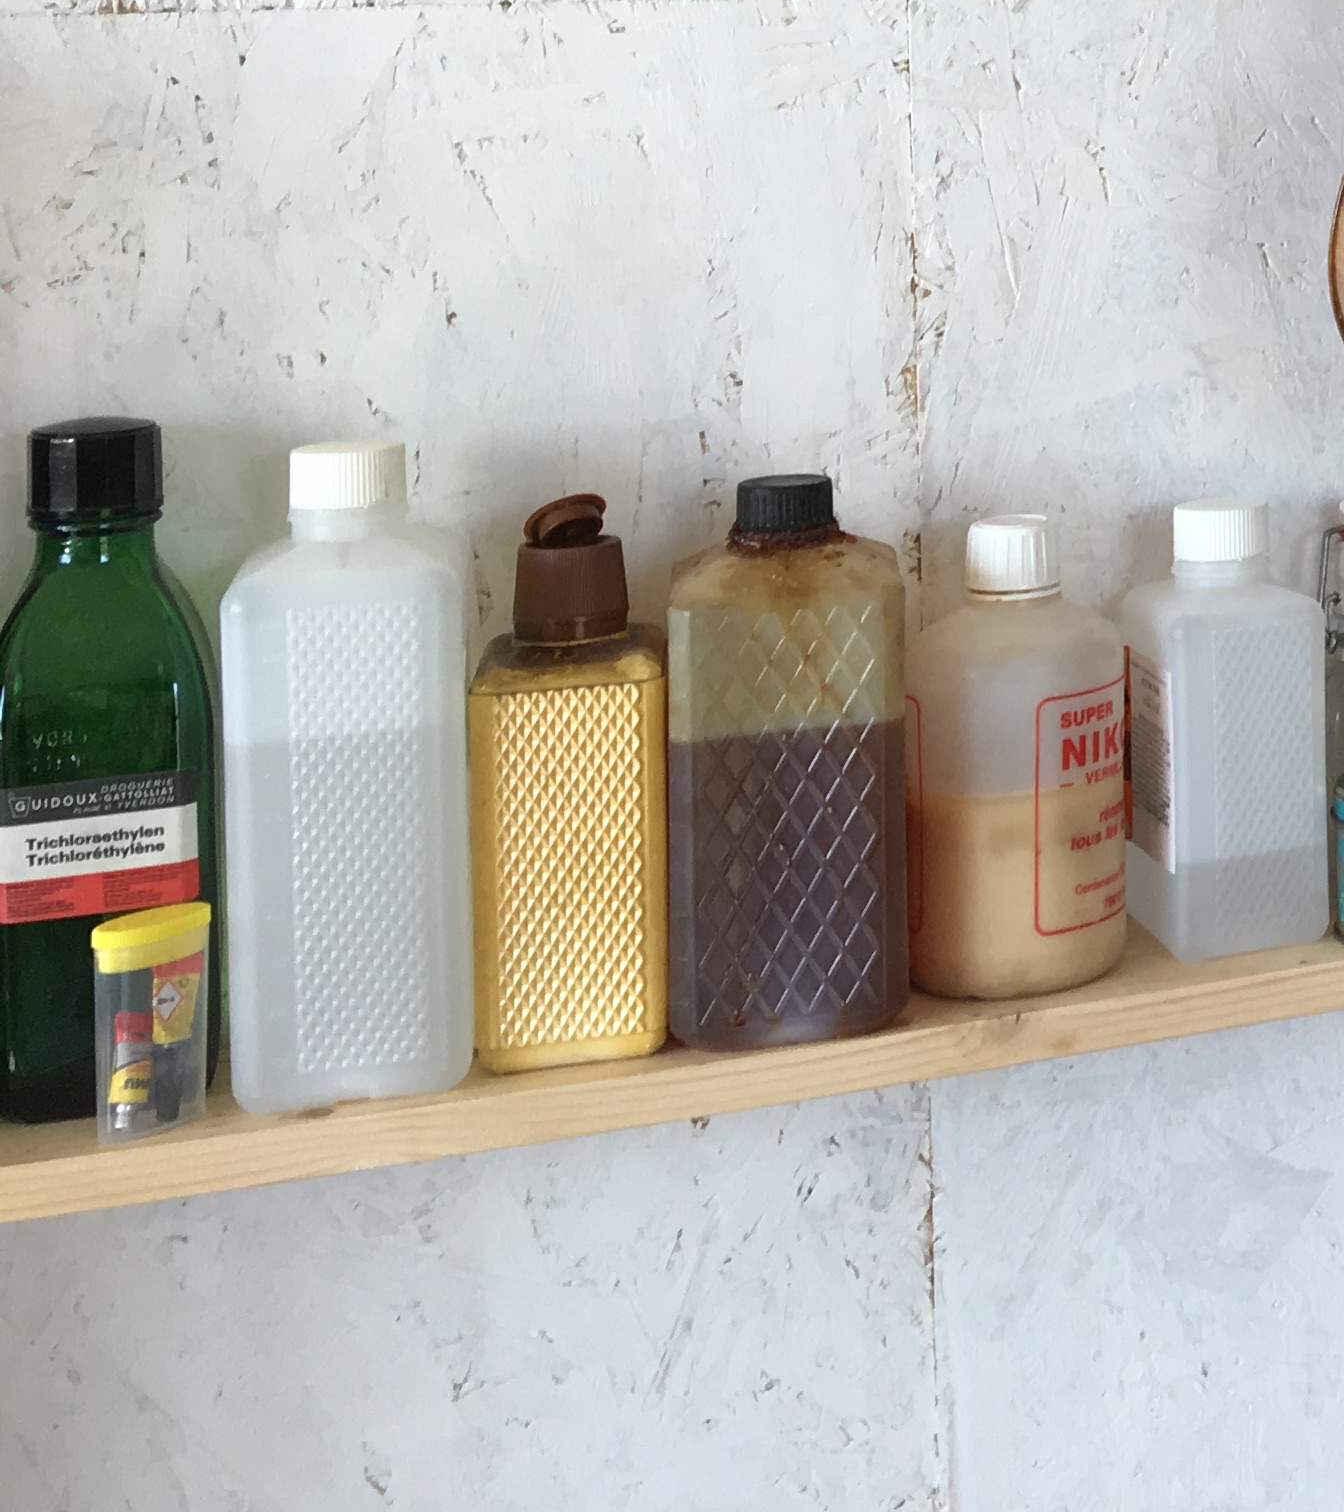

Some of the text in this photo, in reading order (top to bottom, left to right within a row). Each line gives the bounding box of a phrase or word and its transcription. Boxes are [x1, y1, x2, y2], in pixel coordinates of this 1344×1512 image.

[1060, 699, 1113, 729] SUPER
[101, 777, 174, 794] DROGUERIE
[117, 795, 175, 810] YVERDON
[25, 825, 165, 852] Trichloraethylen
[25, 841, 166, 868] Trichloréthylène
